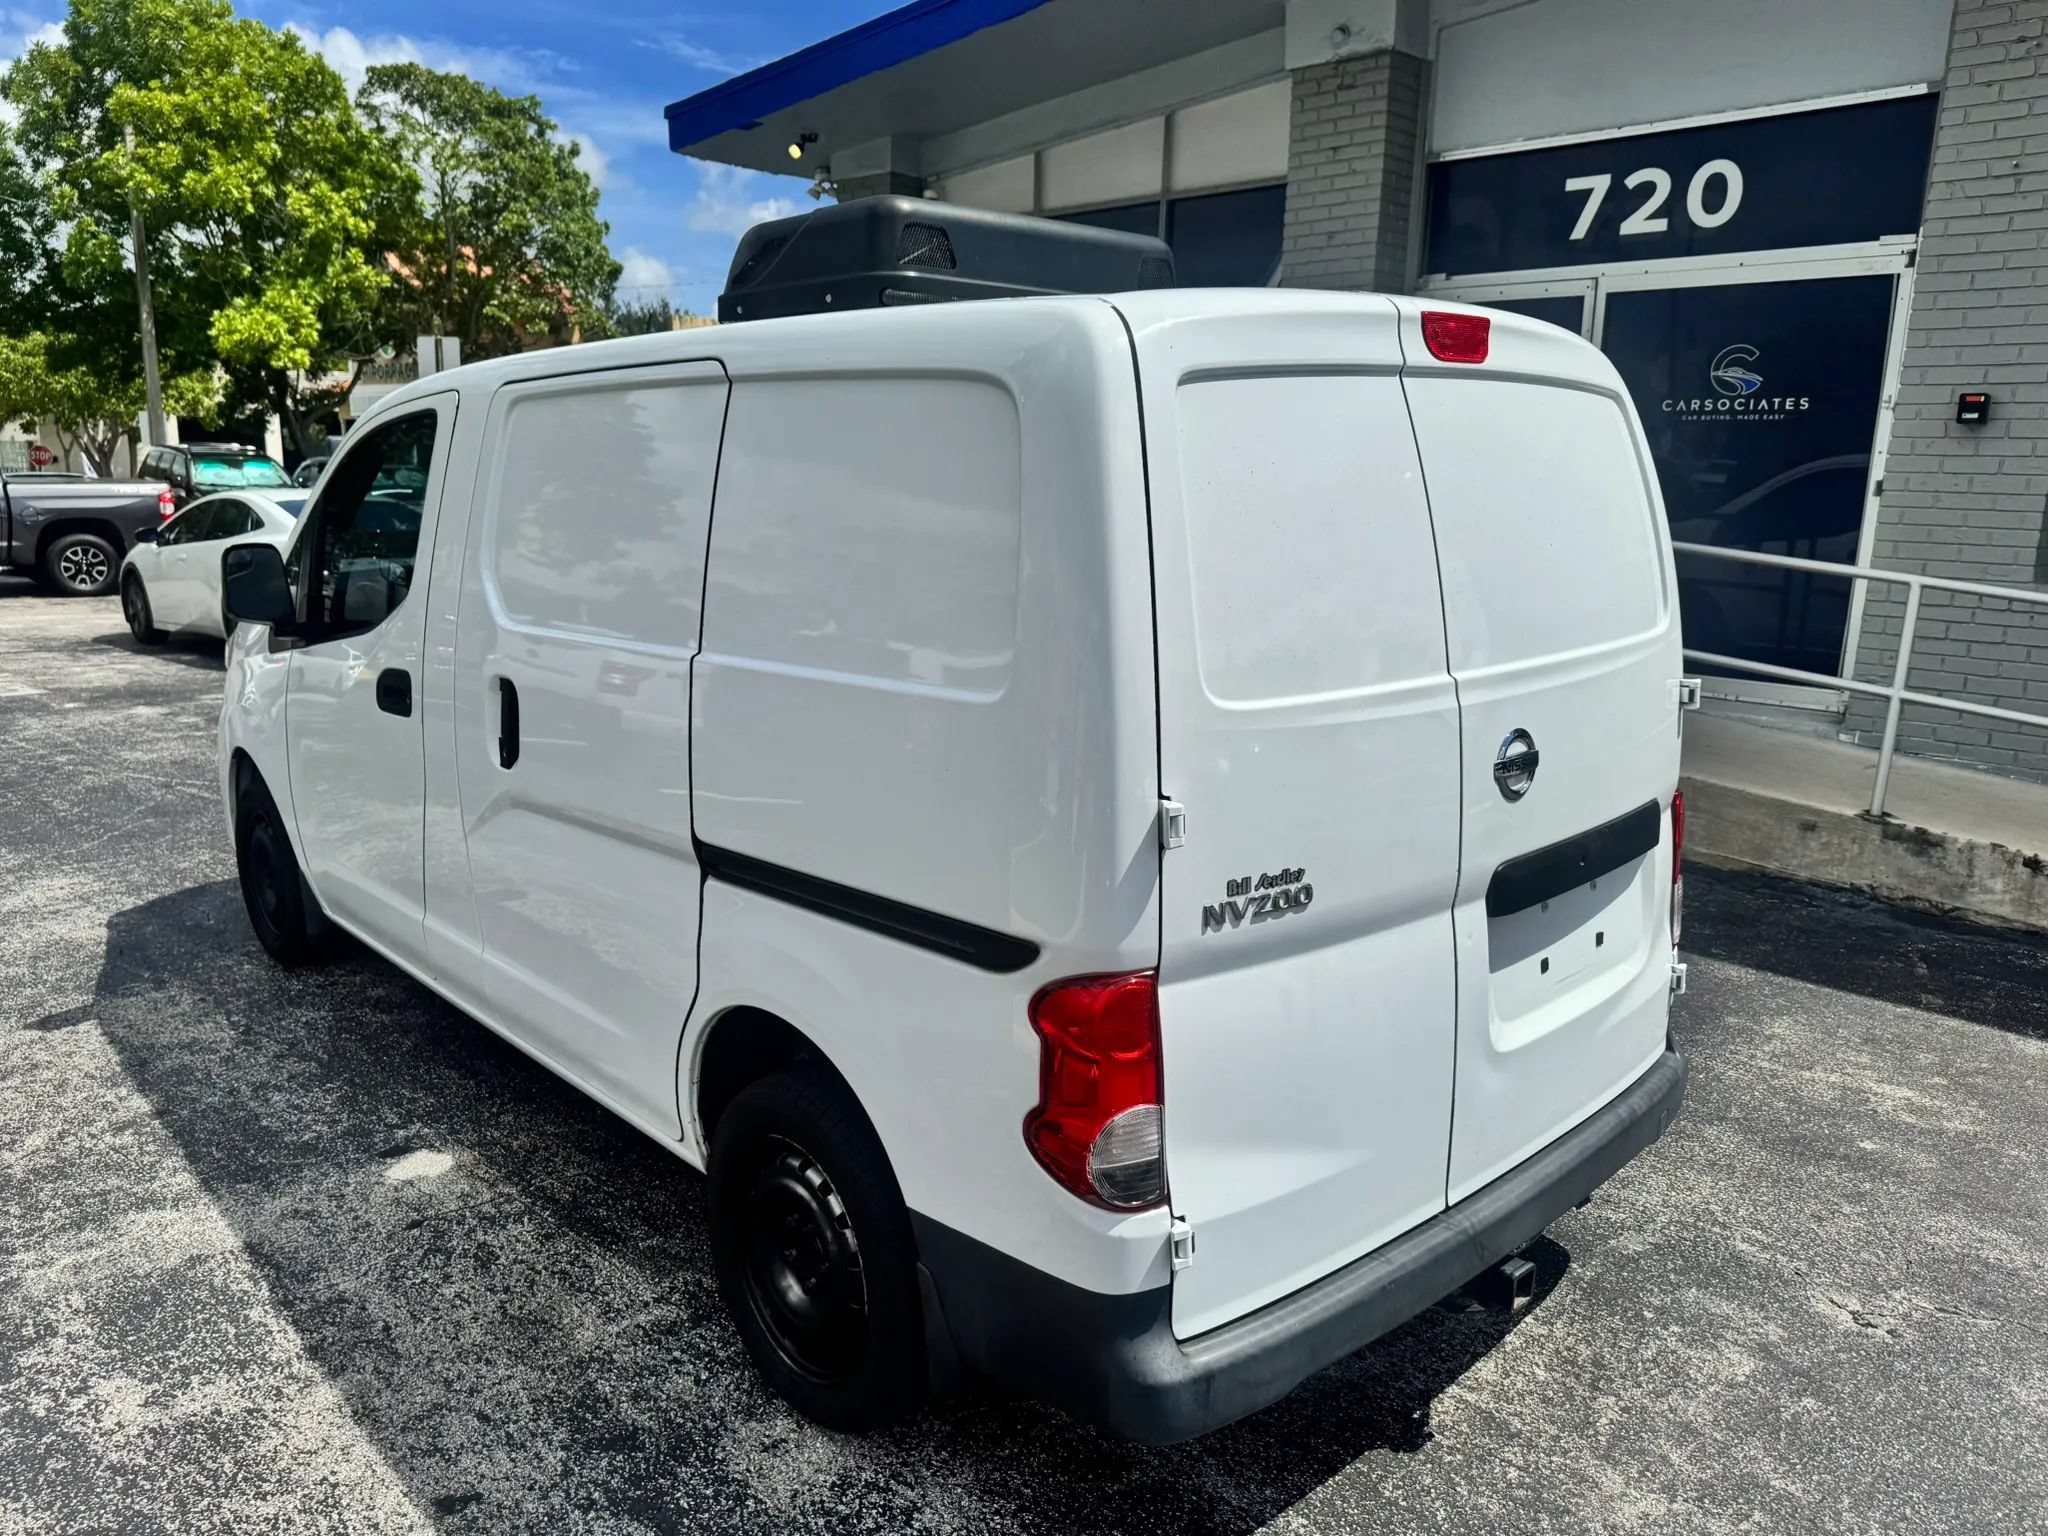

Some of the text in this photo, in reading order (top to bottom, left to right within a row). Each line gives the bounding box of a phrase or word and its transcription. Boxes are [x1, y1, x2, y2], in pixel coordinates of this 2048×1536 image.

[1565, 158, 1744, 240] 720
[1662, 397, 1810, 412] CARSOCIATES
[31, 450, 52, 460] STOP
[1226, 876, 1252, 897] Bill
[1201, 882, 1314, 929] NV200
